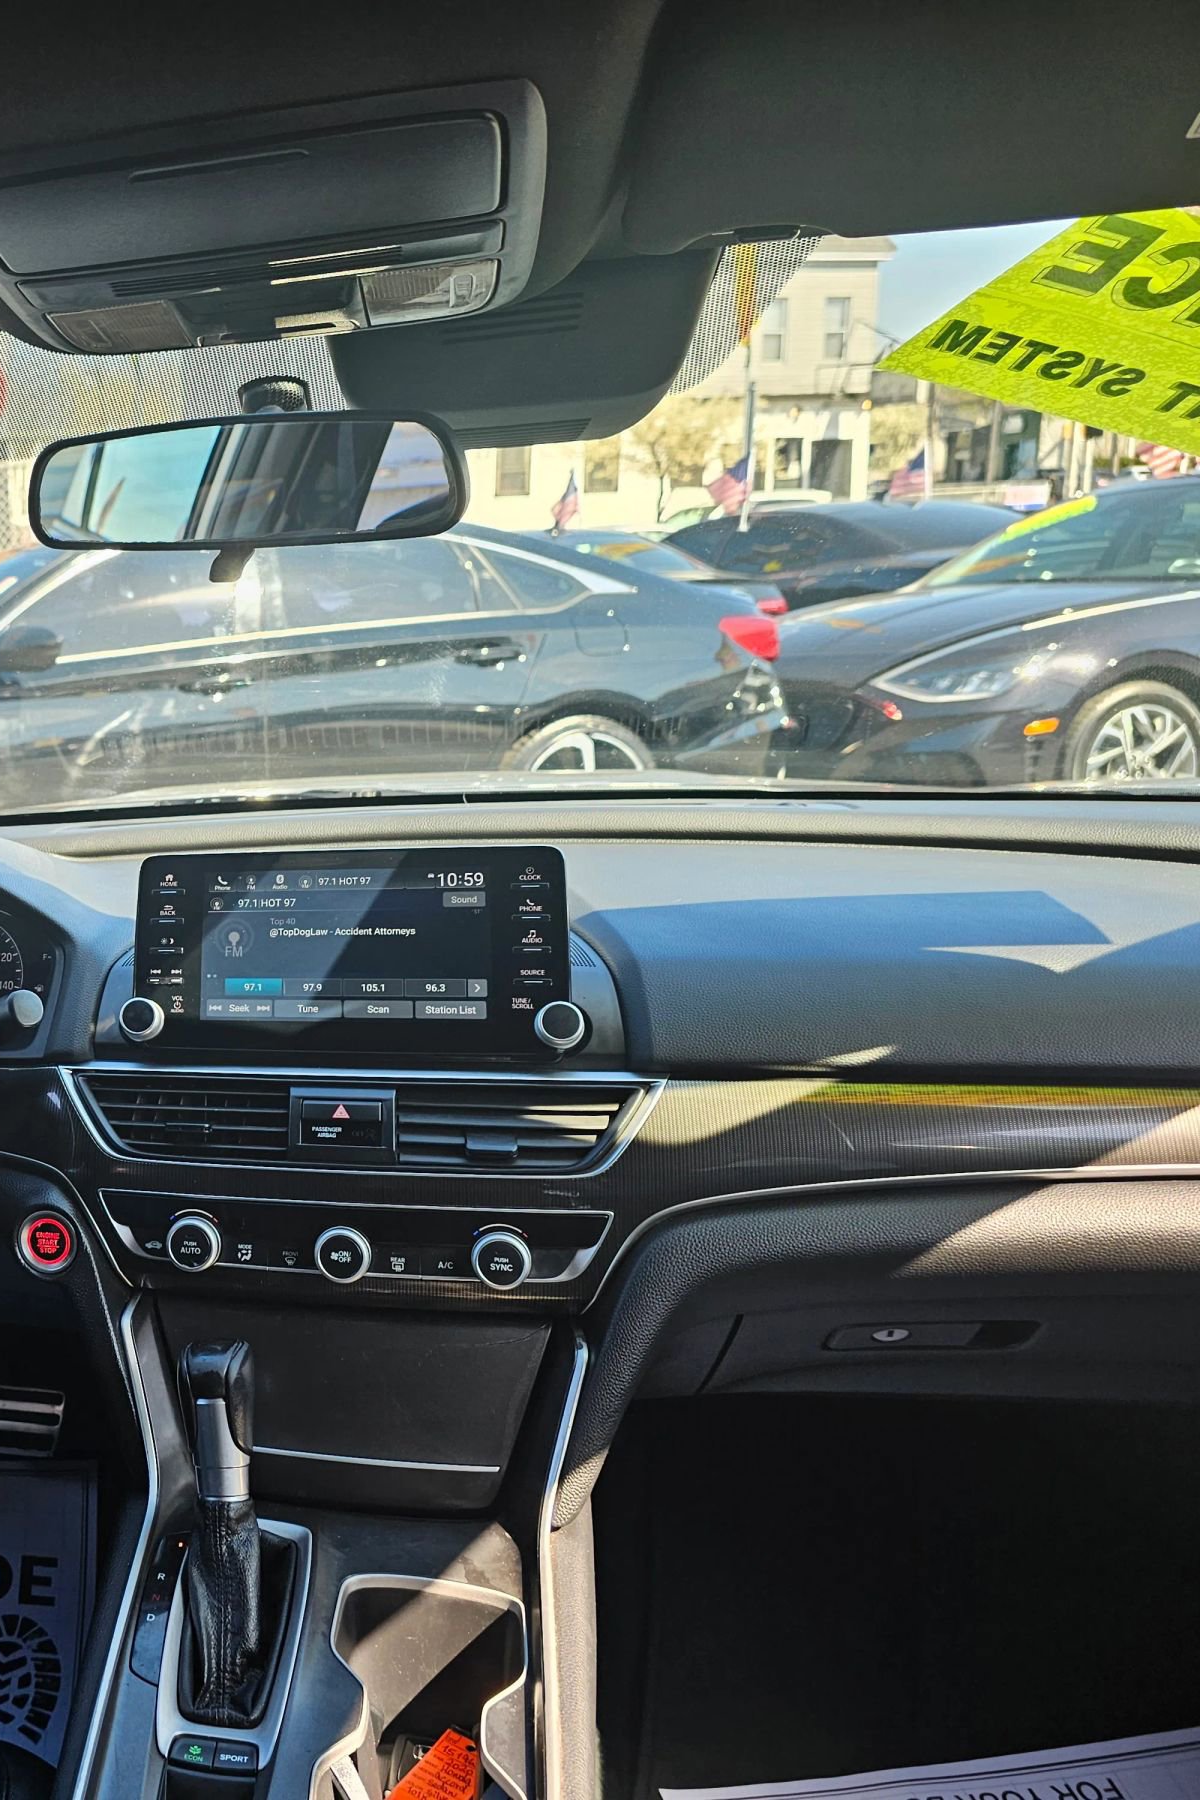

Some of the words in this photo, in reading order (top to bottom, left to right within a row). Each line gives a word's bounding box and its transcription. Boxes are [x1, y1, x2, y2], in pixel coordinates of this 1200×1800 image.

[318, 877, 336, 886] 97.1
[339, 877, 358, 886] HOT
[360, 876, 371, 885] 97
[437, 872, 484, 887] 10:59
[238, 899, 258, 908] 97.1
[261, 898, 282, 907] HOT
[284, 898, 296, 907] 97
[451, 895, 478, 903] Sound
[270, 918, 285, 926] Top
[270, 928, 328, 938] @TopDogLaw
[335, 927, 372, 936] Accident
[374, 926, 416, 936] Attorneys
[225, 946, 243, 957] FM
[0, 980, 14, 990] 140
[244, 983, 262, 992] 97.1
[303, 983, 322, 992] 97.9
[361, 983, 385, 992] 105.1
[425, 983, 446, 992] 96.3
[229, 1004, 249, 1013] Seek
[297, 1004, 319, 1013] Tune
[367, 1005, 389, 1014] Scan
[425, 1005, 458, 1014] Station
[460, 1005, 476, 1015] List
[36, 1231, 60, 1239] ENGINE
[37, 1238, 59, 1246] START
[180, 1246, 201, 1255] AUTO
[437, 1261, 454, 1270] A/C
[490, 1263, 513, 1272] SYNC
[157, 1572, 166, 1581] R
[146, 1613, 156, 1622] D
[184, 1754, 204, 1762] ECON
[219, 1753, 249, 1764] SPORT
